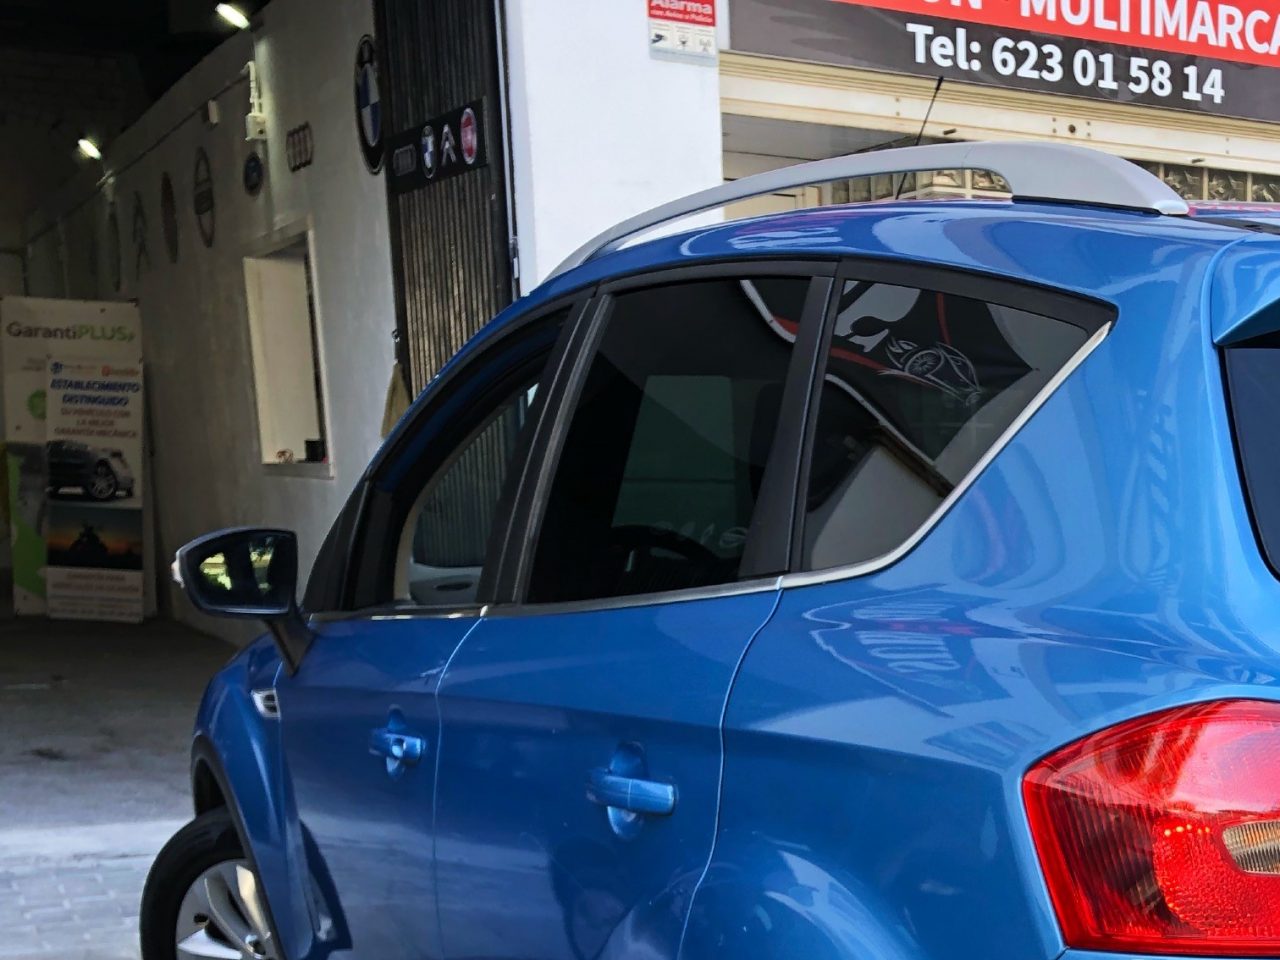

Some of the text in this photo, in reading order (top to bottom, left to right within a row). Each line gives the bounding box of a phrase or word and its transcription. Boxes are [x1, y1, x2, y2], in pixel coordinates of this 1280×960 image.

[906, 22, 1225, 104] Tel: 623 01 58 14
